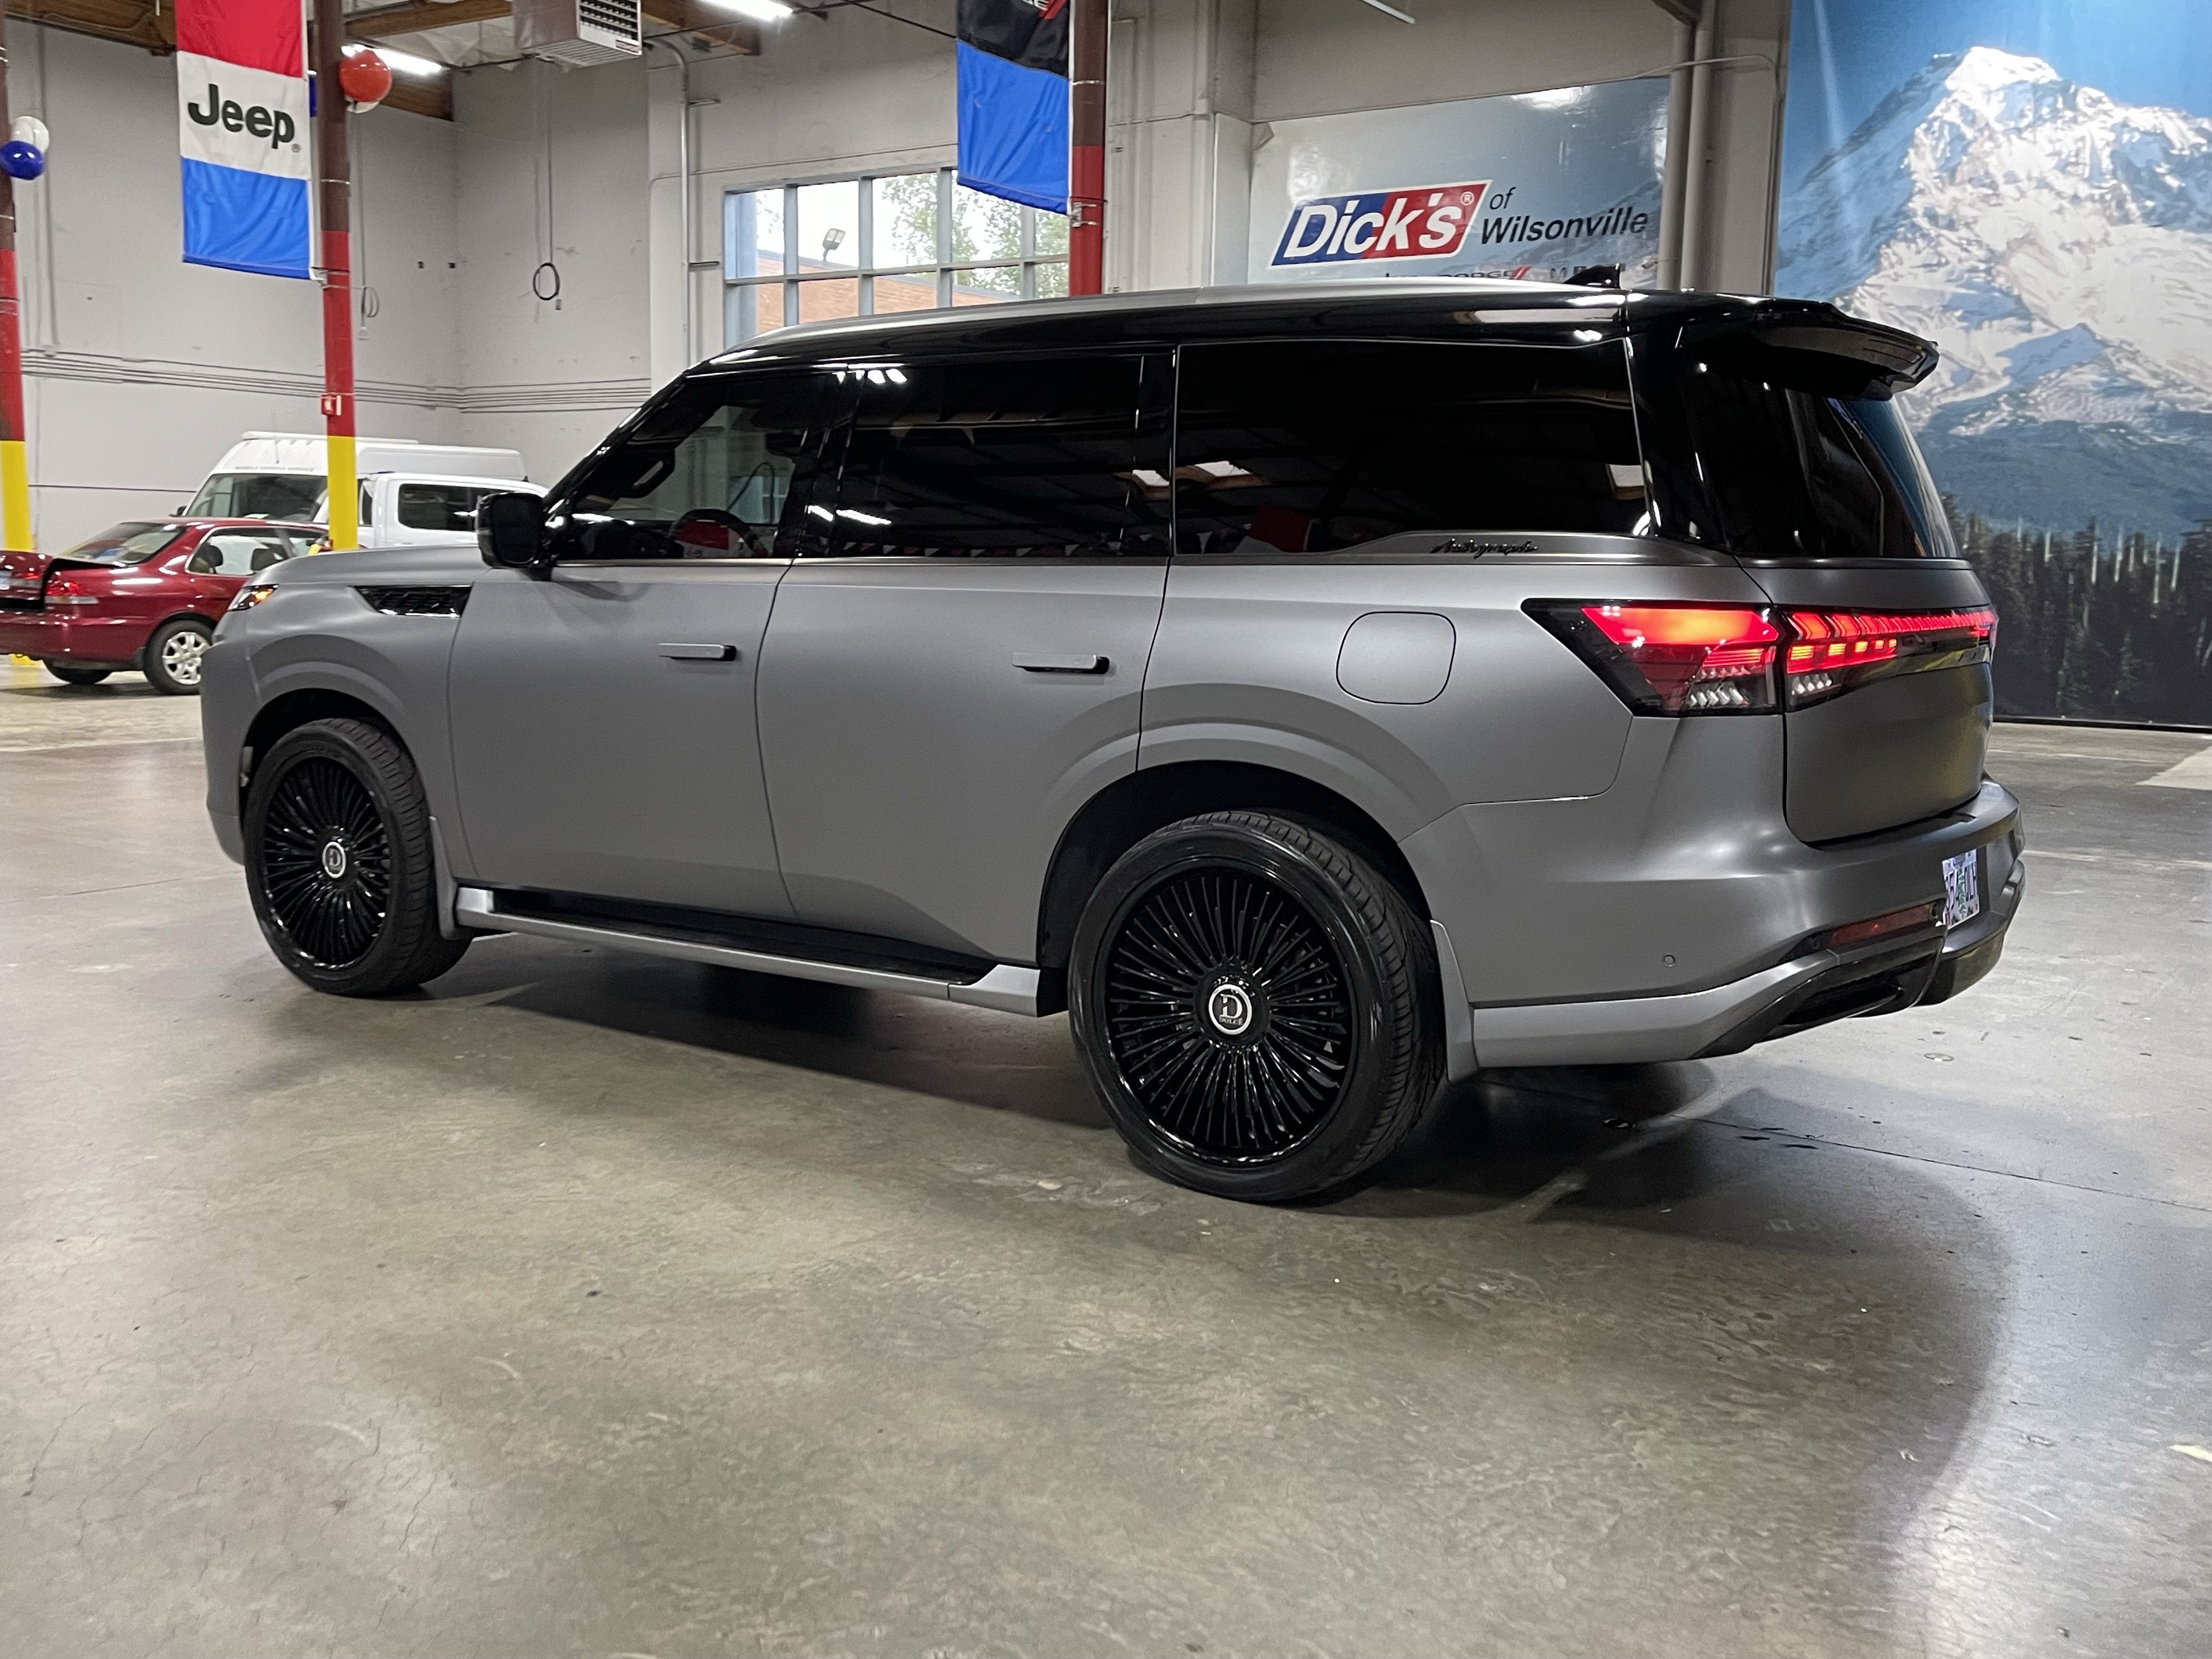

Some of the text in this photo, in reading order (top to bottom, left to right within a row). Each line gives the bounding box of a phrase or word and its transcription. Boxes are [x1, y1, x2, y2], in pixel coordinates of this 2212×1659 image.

[188, 83, 295, 149] Jeep
[1489, 187, 1516, 210] of
[1481, 206, 1648, 245] Wilsonville
